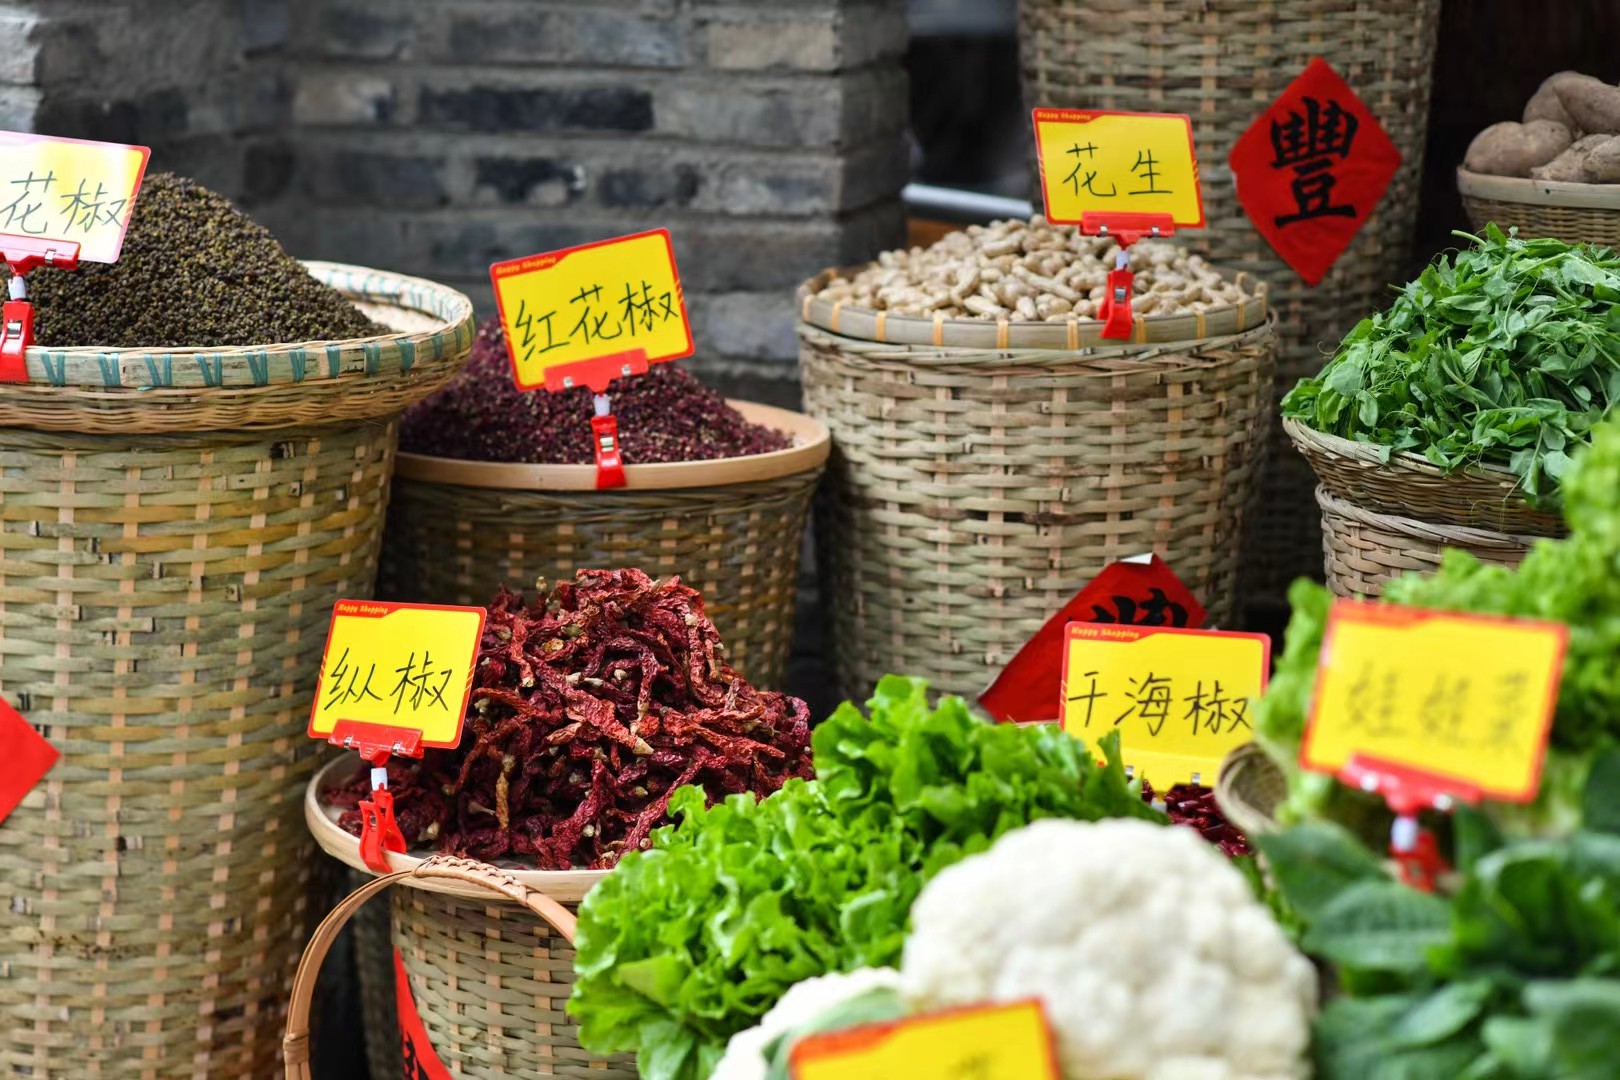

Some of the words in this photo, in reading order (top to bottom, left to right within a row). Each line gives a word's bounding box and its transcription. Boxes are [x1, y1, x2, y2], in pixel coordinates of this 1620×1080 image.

[1062, 142, 1173, 197] 花生
[1270, 96, 1358, 230] 豐
[0, 170, 127, 235] 花椒
[515, 280, 678, 361] 红花椒
[338, 603, 358, 613] Happy
[359, 604, 389, 615] Shopping
[1071, 626, 1098, 637] Happy
[1101, 628, 1140, 639] Shopping
[1068, 671, 1254, 737] 干海椒
